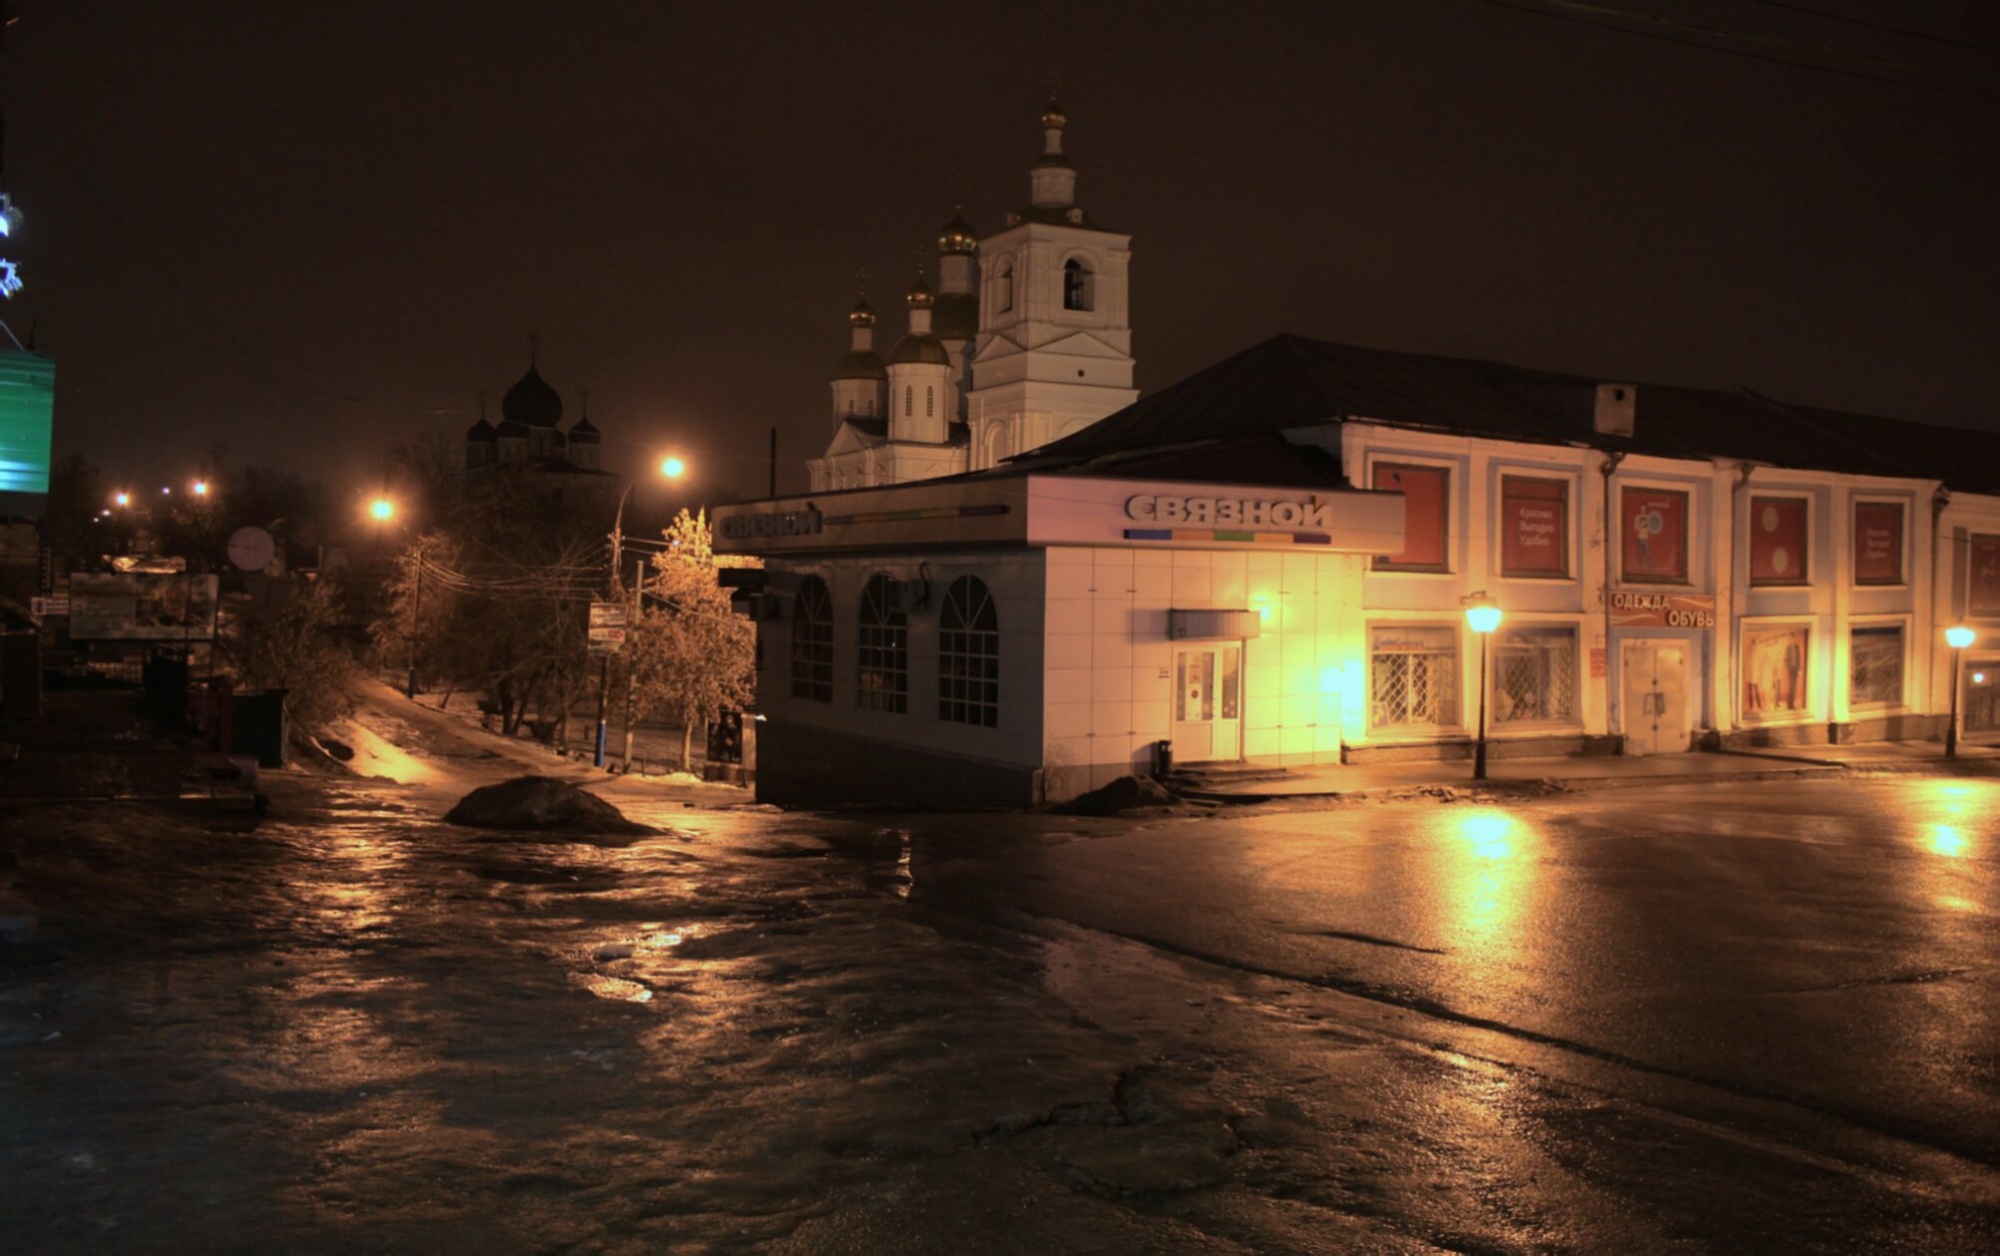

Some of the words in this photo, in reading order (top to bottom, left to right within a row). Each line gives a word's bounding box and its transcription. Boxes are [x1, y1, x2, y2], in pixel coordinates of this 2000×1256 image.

[1124, 494, 1332, 528] СВЯЗНОЙ
[1612, 594, 1670, 609] ОДЕЖДА
[1667, 610, 1714, 627] ОБУВЬ
